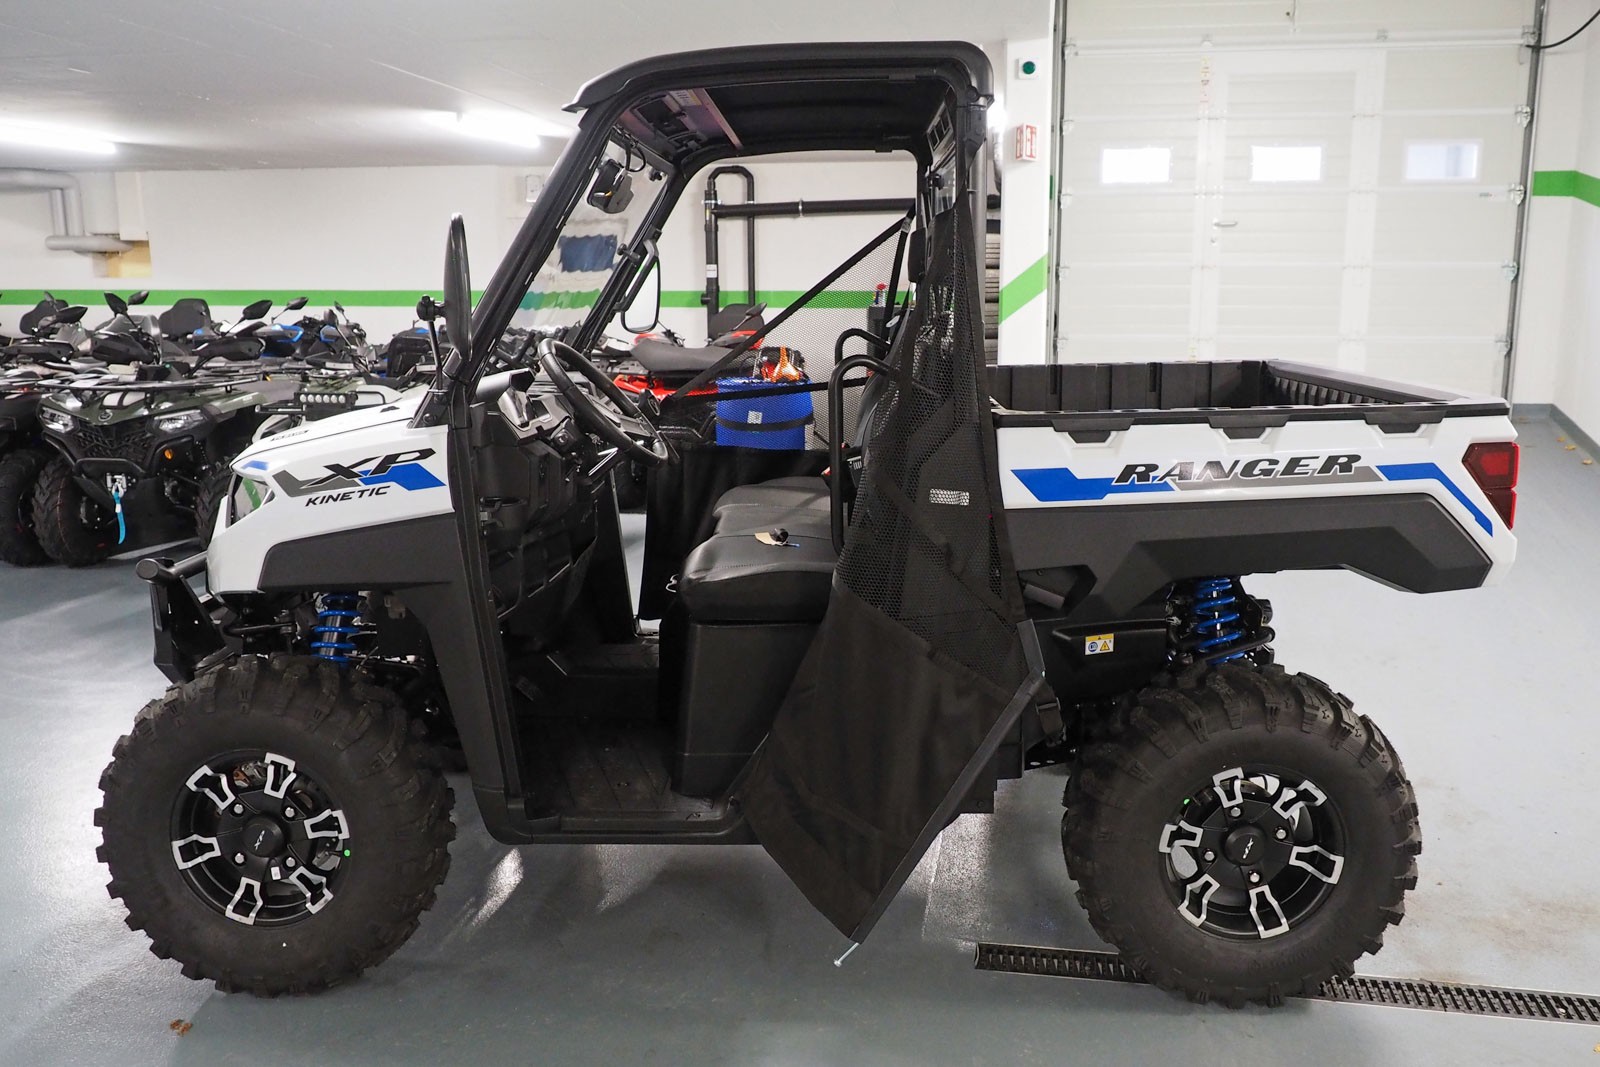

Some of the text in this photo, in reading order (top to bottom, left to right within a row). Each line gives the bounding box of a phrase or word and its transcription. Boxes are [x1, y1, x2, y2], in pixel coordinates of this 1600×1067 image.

[305, 447, 437, 487] XP
[1113, 453, 1362, 485] RANGER
[305, 485, 391, 507] KINETIC
